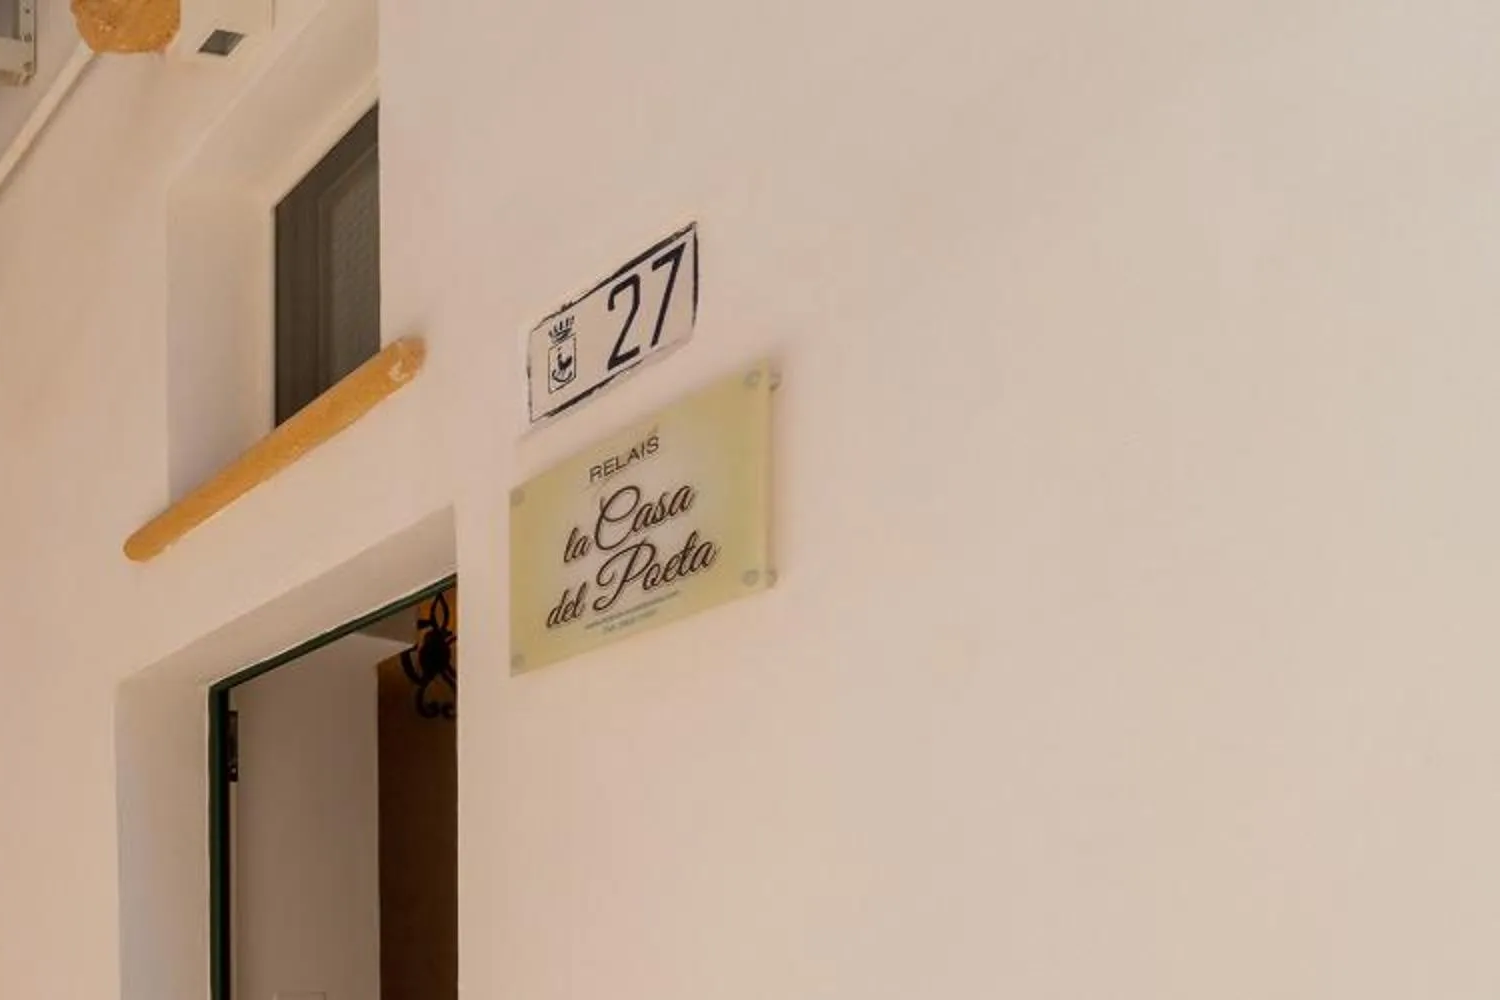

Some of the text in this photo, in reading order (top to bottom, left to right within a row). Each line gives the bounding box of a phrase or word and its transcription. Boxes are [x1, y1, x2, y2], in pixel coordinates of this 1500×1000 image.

[607, 242, 687, 371] 27
[589, 435, 660, 482] RELAIS
[564, 485, 695, 563] la Casa
[546, 582, 586, 628] del
[593, 531, 718, 611] Poeta
